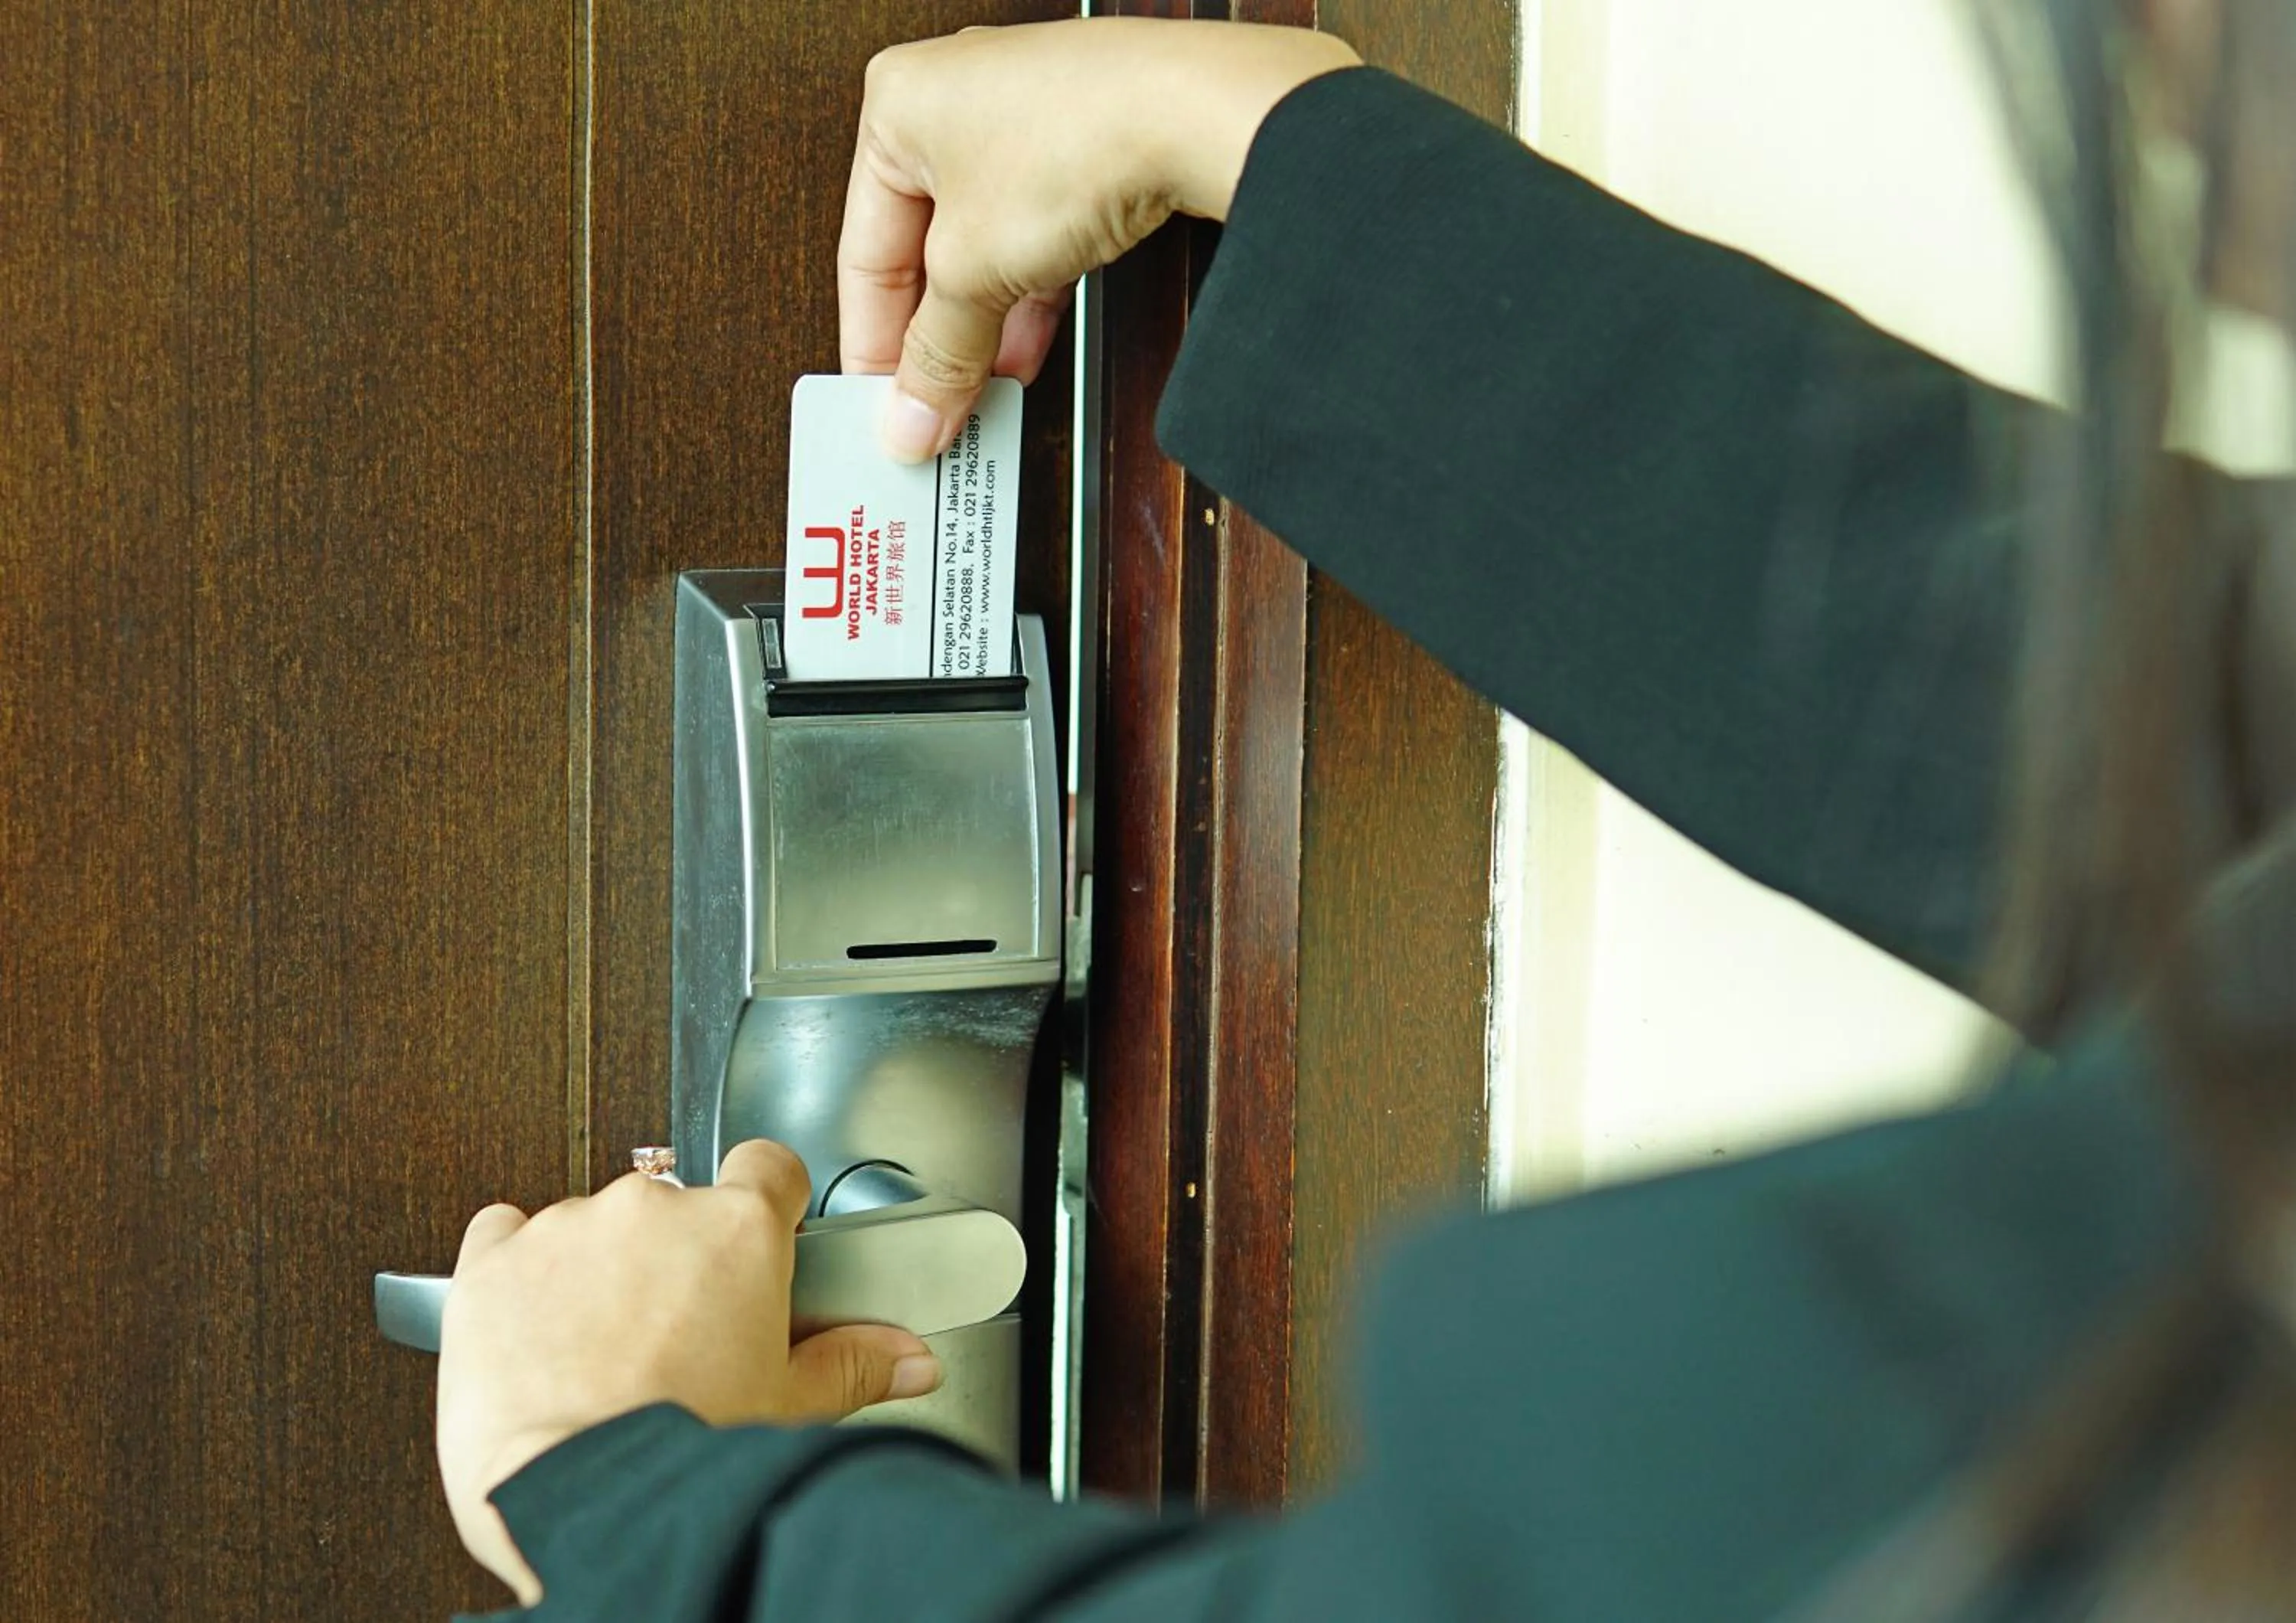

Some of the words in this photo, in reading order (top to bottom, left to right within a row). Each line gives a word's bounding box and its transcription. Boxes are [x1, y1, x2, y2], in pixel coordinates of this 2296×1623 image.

[966, 414, 980, 487] 29620889
[947, 465, 960, 513] Jakarta
[965, 492, 977, 517] 021
[850, 505, 864, 567] HOTEL
[963, 531, 974, 553] Fax
[979, 460, 996, 613] www.worldhtljkt.com
[866, 529, 879, 616] JAKARTA
[885, 521, 906, 625] 新世界旅馆
[944, 569, 955, 617] Selatan
[847, 573, 862, 640] WORLD
[959, 645, 970, 669] 021
